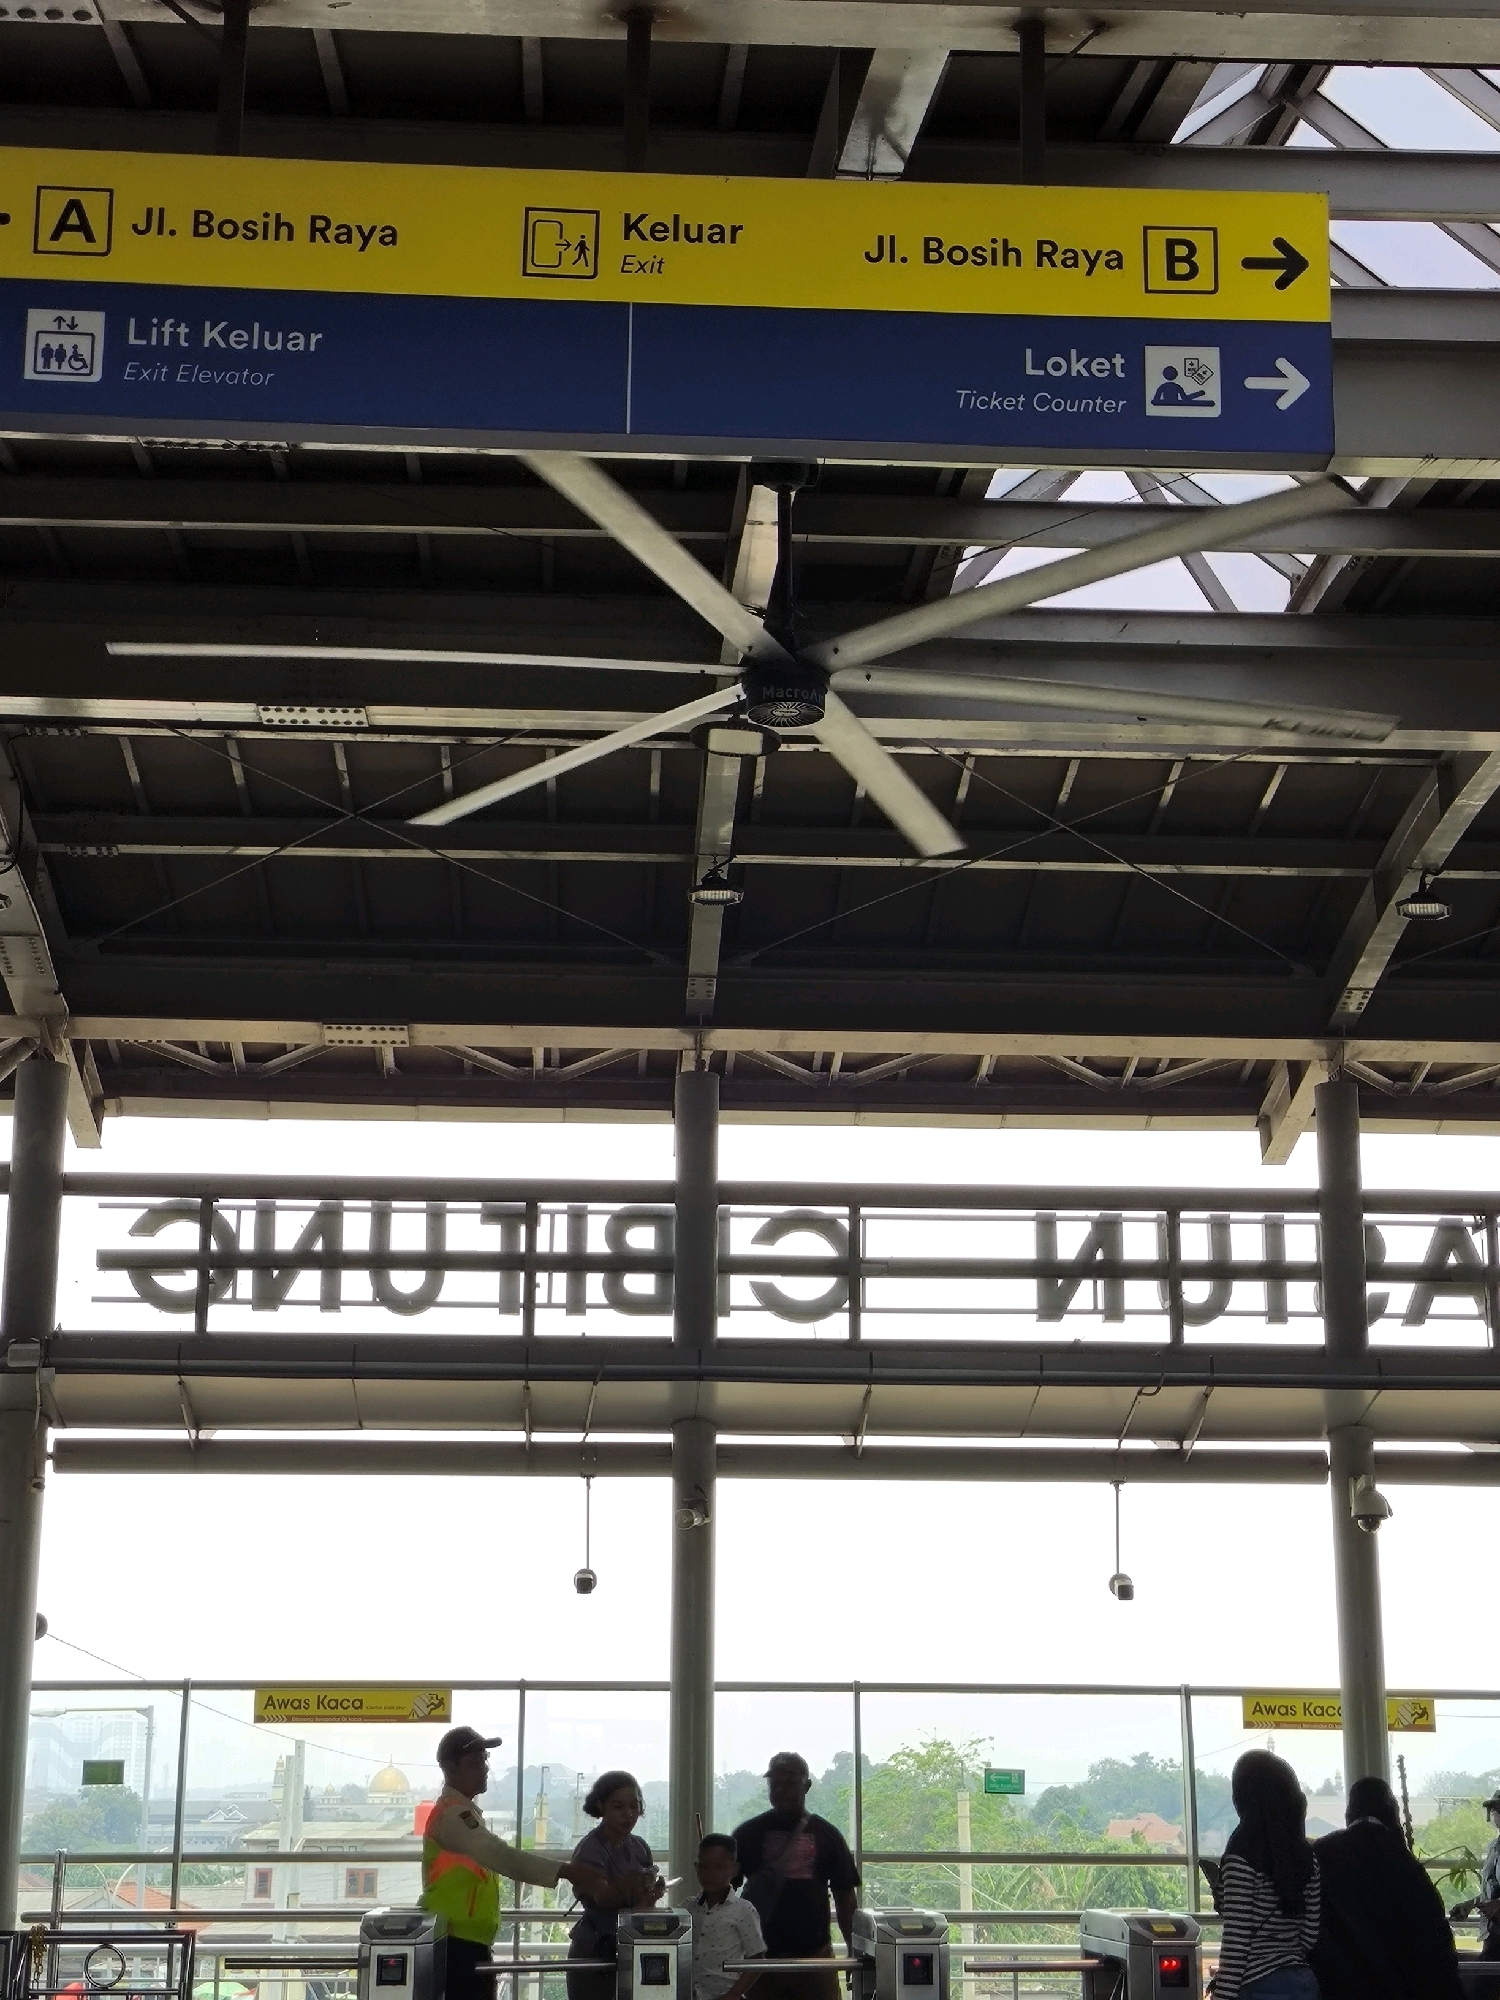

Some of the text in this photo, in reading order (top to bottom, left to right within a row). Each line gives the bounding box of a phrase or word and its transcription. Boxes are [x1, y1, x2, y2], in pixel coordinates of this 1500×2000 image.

[49, 198, 398, 253] A Jl. Bosih Raya
[623, 212, 744, 245] Keluar
[620, 254, 666, 275] Exit
[864, 234, 1200, 282] Jl. Bosih Raya B
[128, 317, 323, 352] Lift Keluar
[123, 361, 275, 386] Exit Elevator
[1025, 348, 1126, 378] Loket
[956, 389, 1127, 413] Ticket Counter
[263, 1694, 310, 1711] Awas
[316, 1694, 364, 1711] Kaca
[1251, 1701, 1342, 1717] Awas Kac
